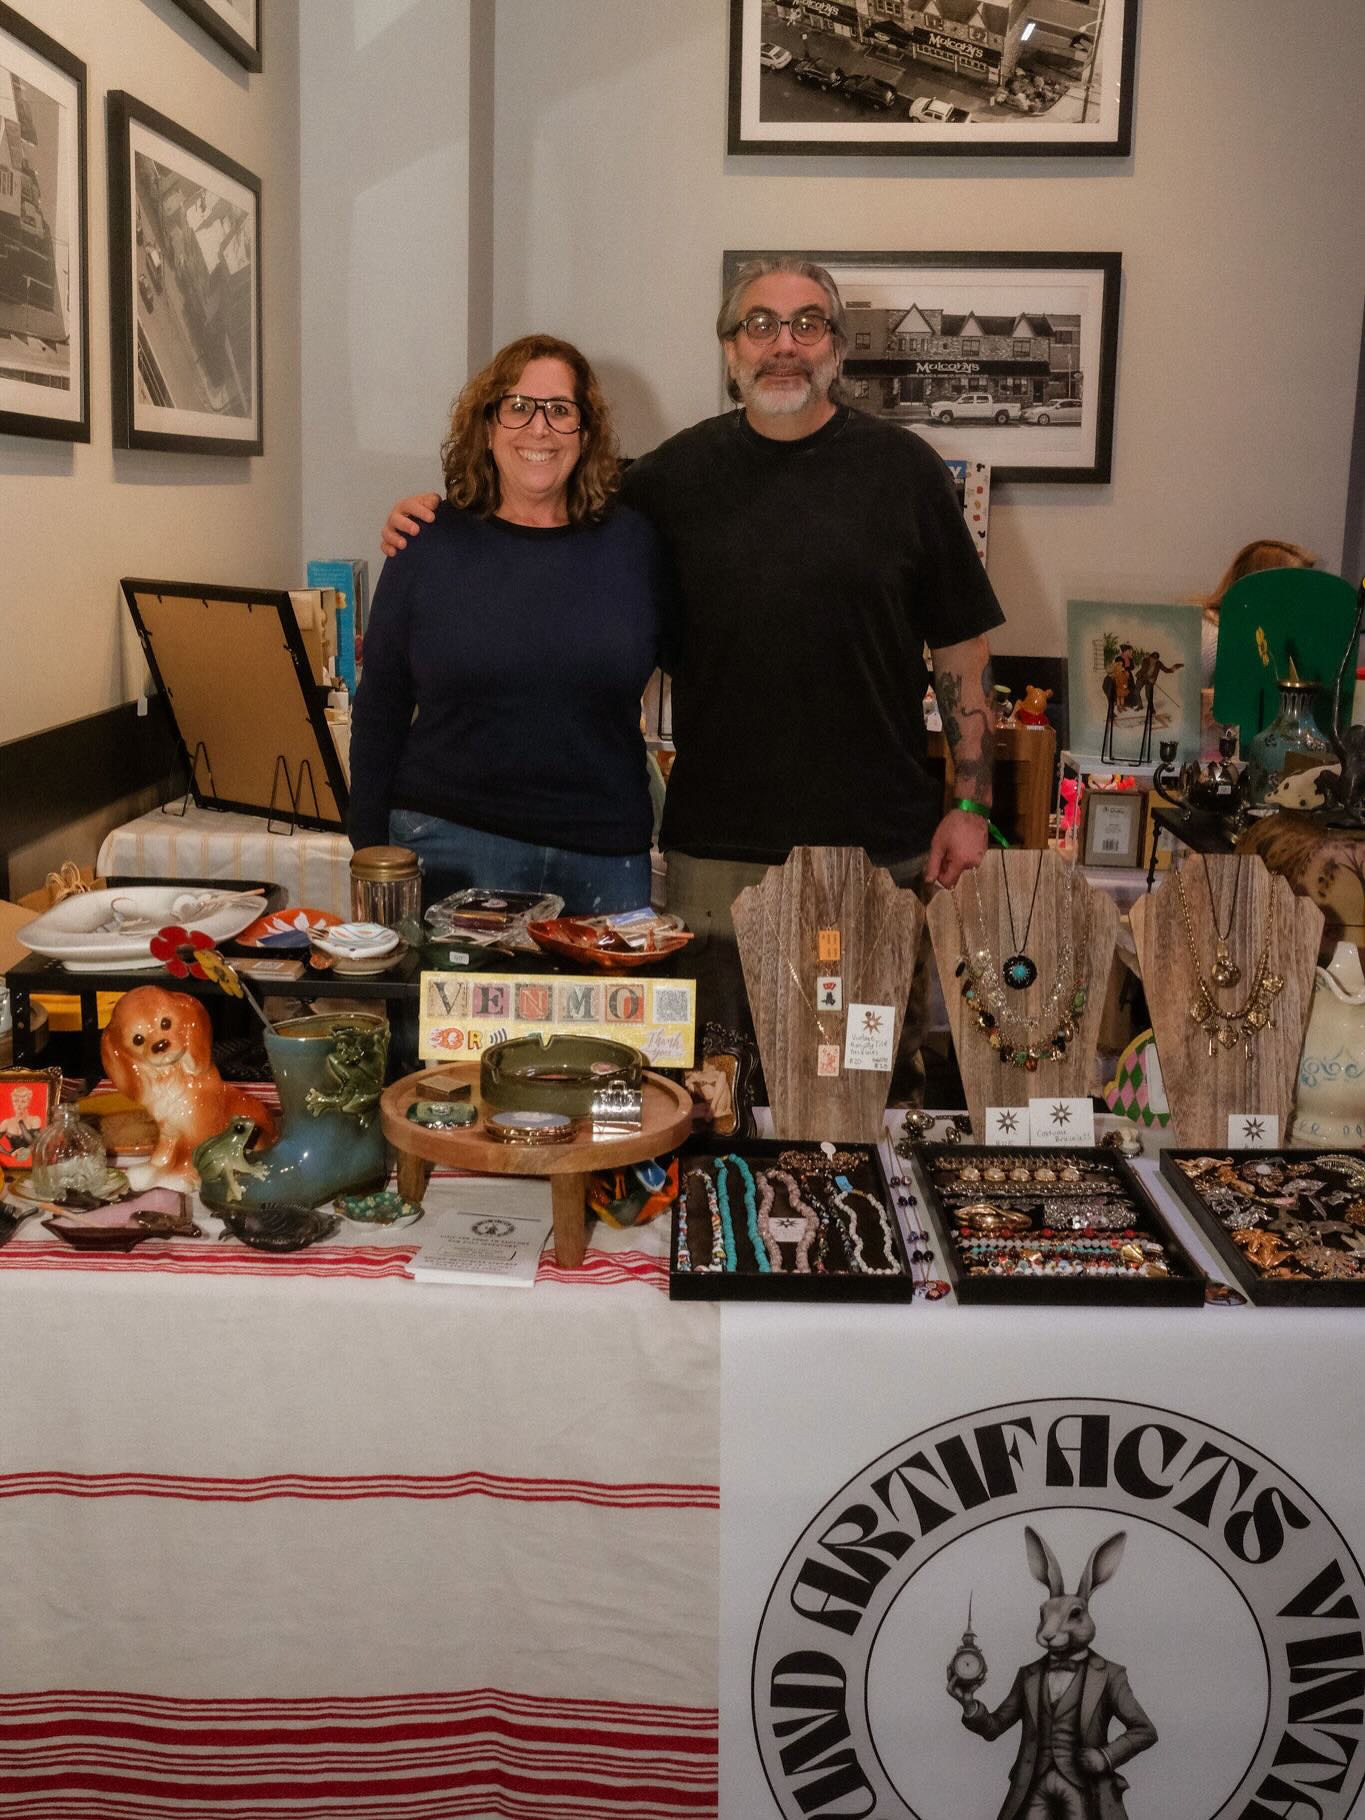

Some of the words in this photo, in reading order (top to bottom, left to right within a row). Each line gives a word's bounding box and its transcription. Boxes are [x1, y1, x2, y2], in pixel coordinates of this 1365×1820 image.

[432, 980, 642, 1021] VENMO
[435, 1027, 483, 1050] OR
[790, 1414, 1311, 1636] ARTIFACTS
